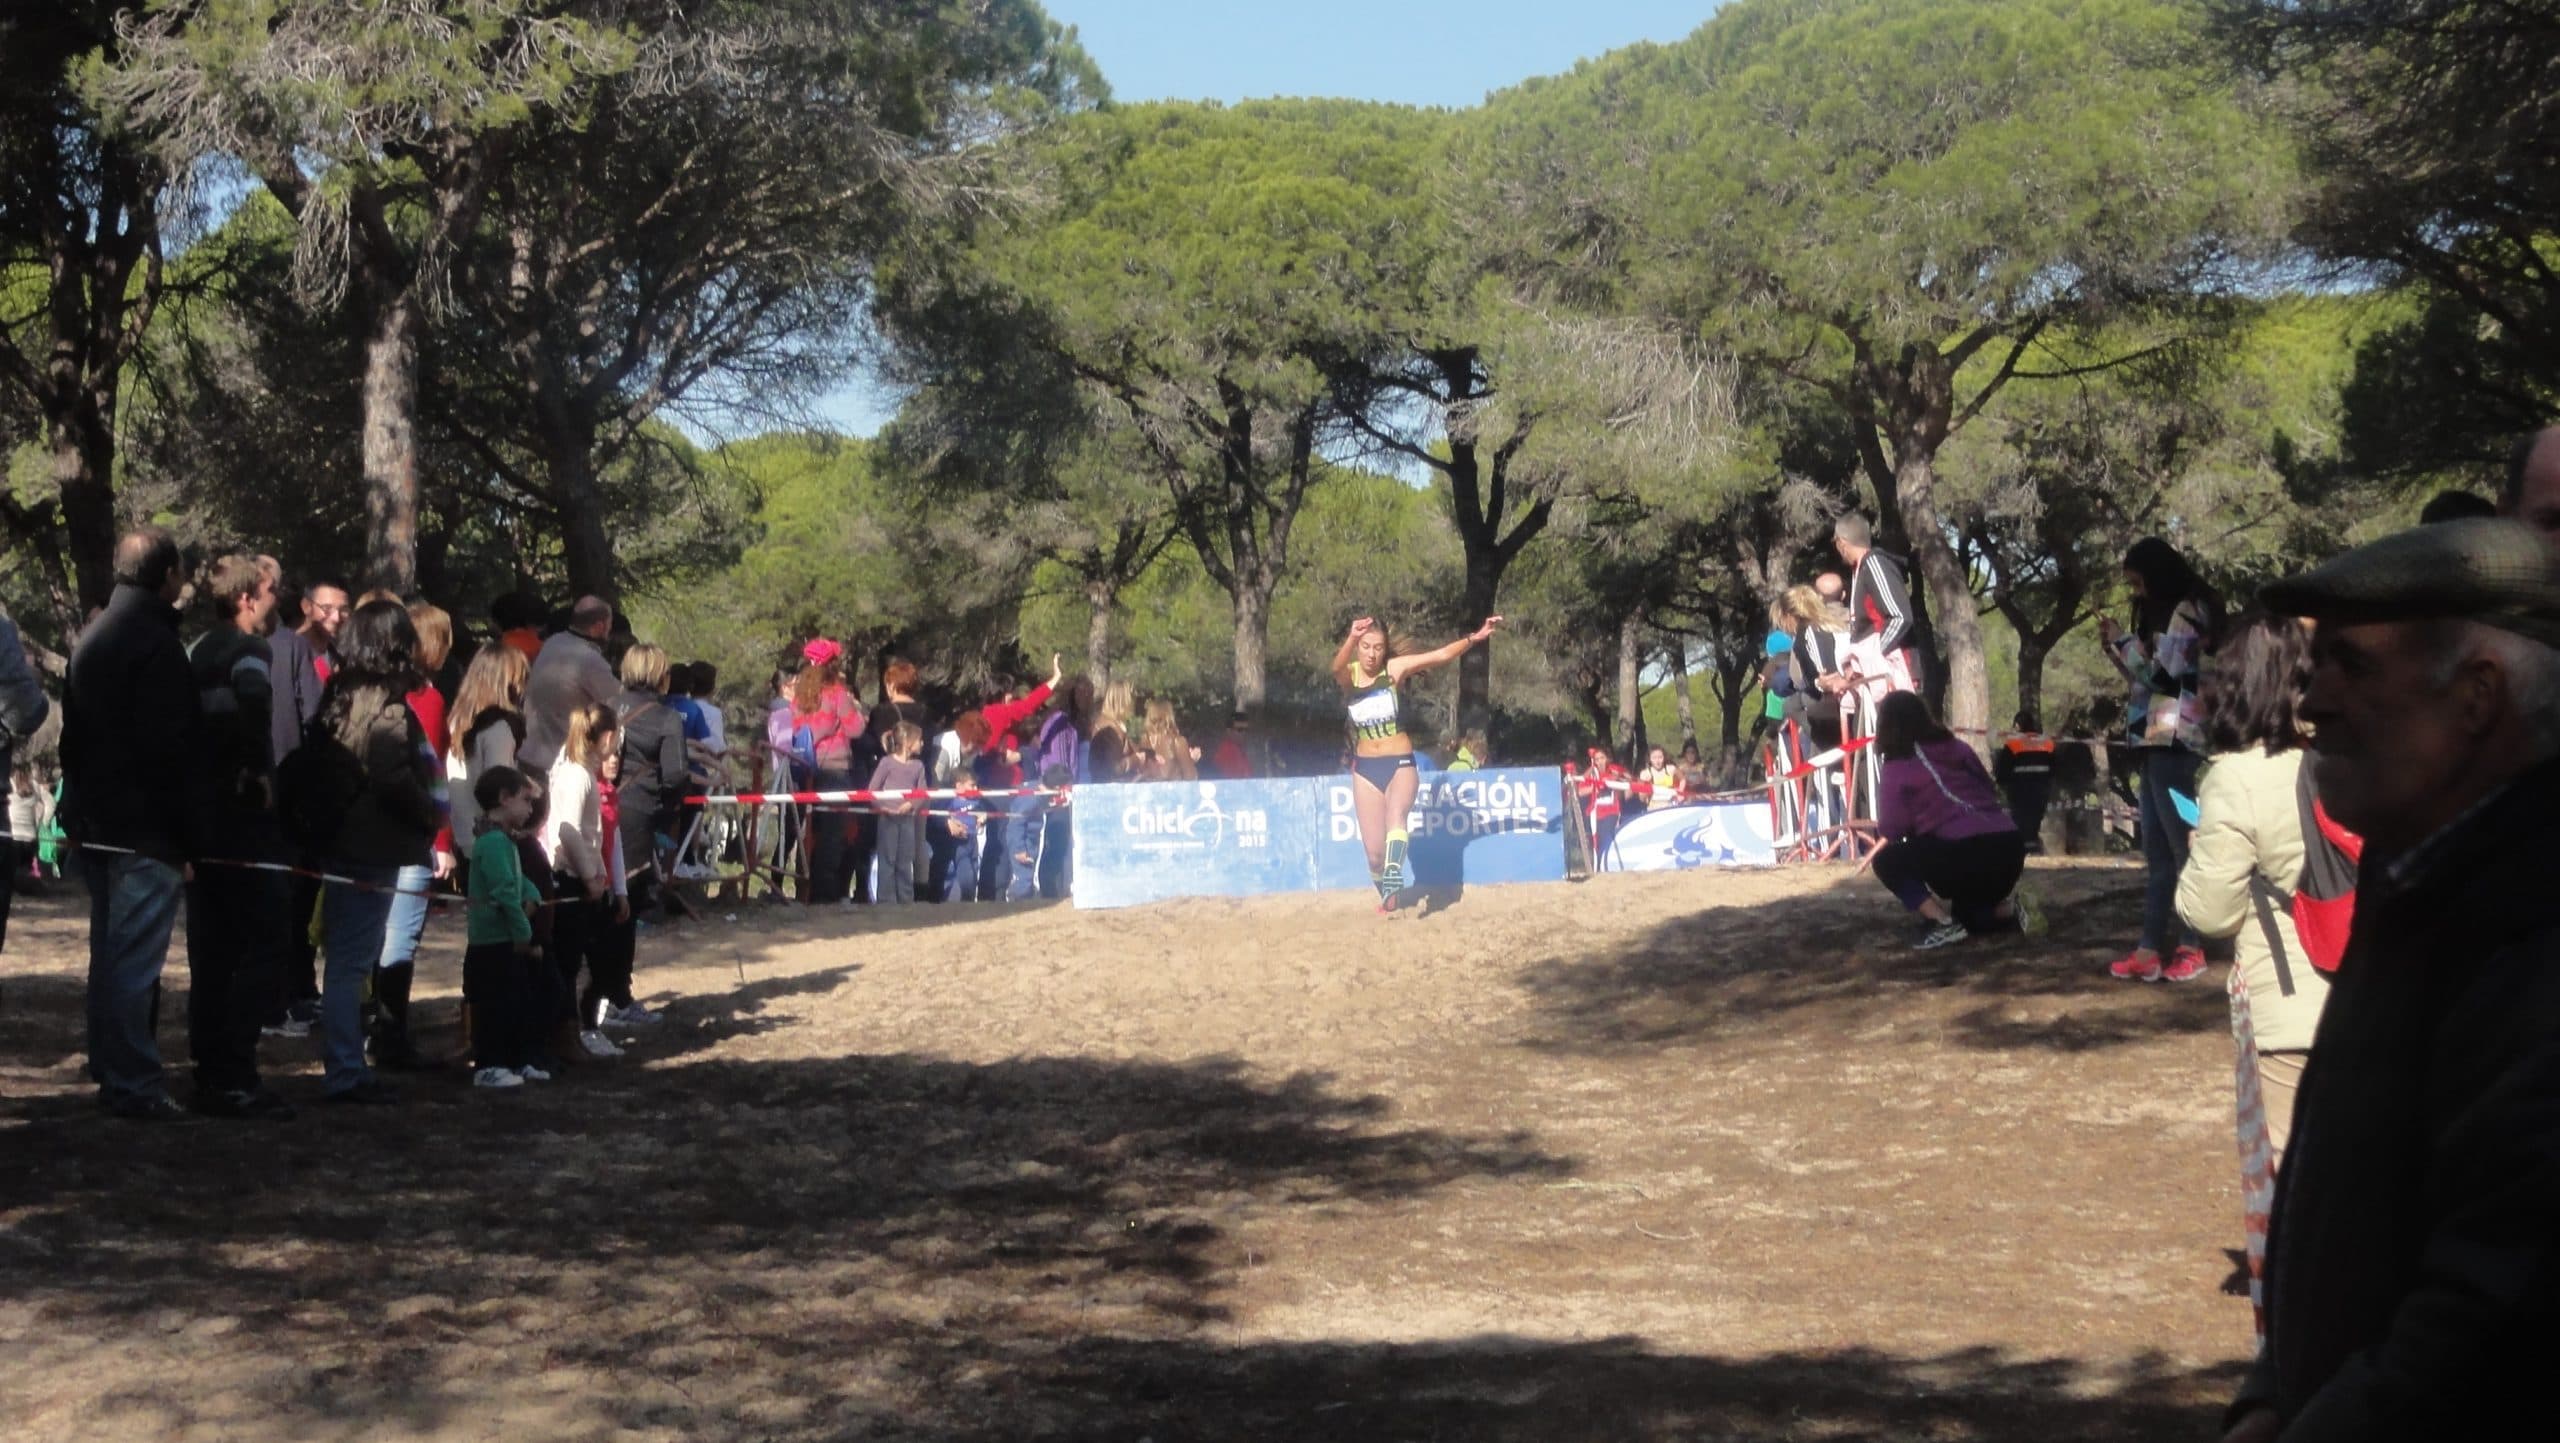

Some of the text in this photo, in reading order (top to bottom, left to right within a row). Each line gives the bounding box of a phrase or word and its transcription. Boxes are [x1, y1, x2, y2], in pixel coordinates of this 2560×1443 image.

[1330, 774, 1537, 813] DGACIÓN
[1331, 806, 1549, 841] D EPORTES
